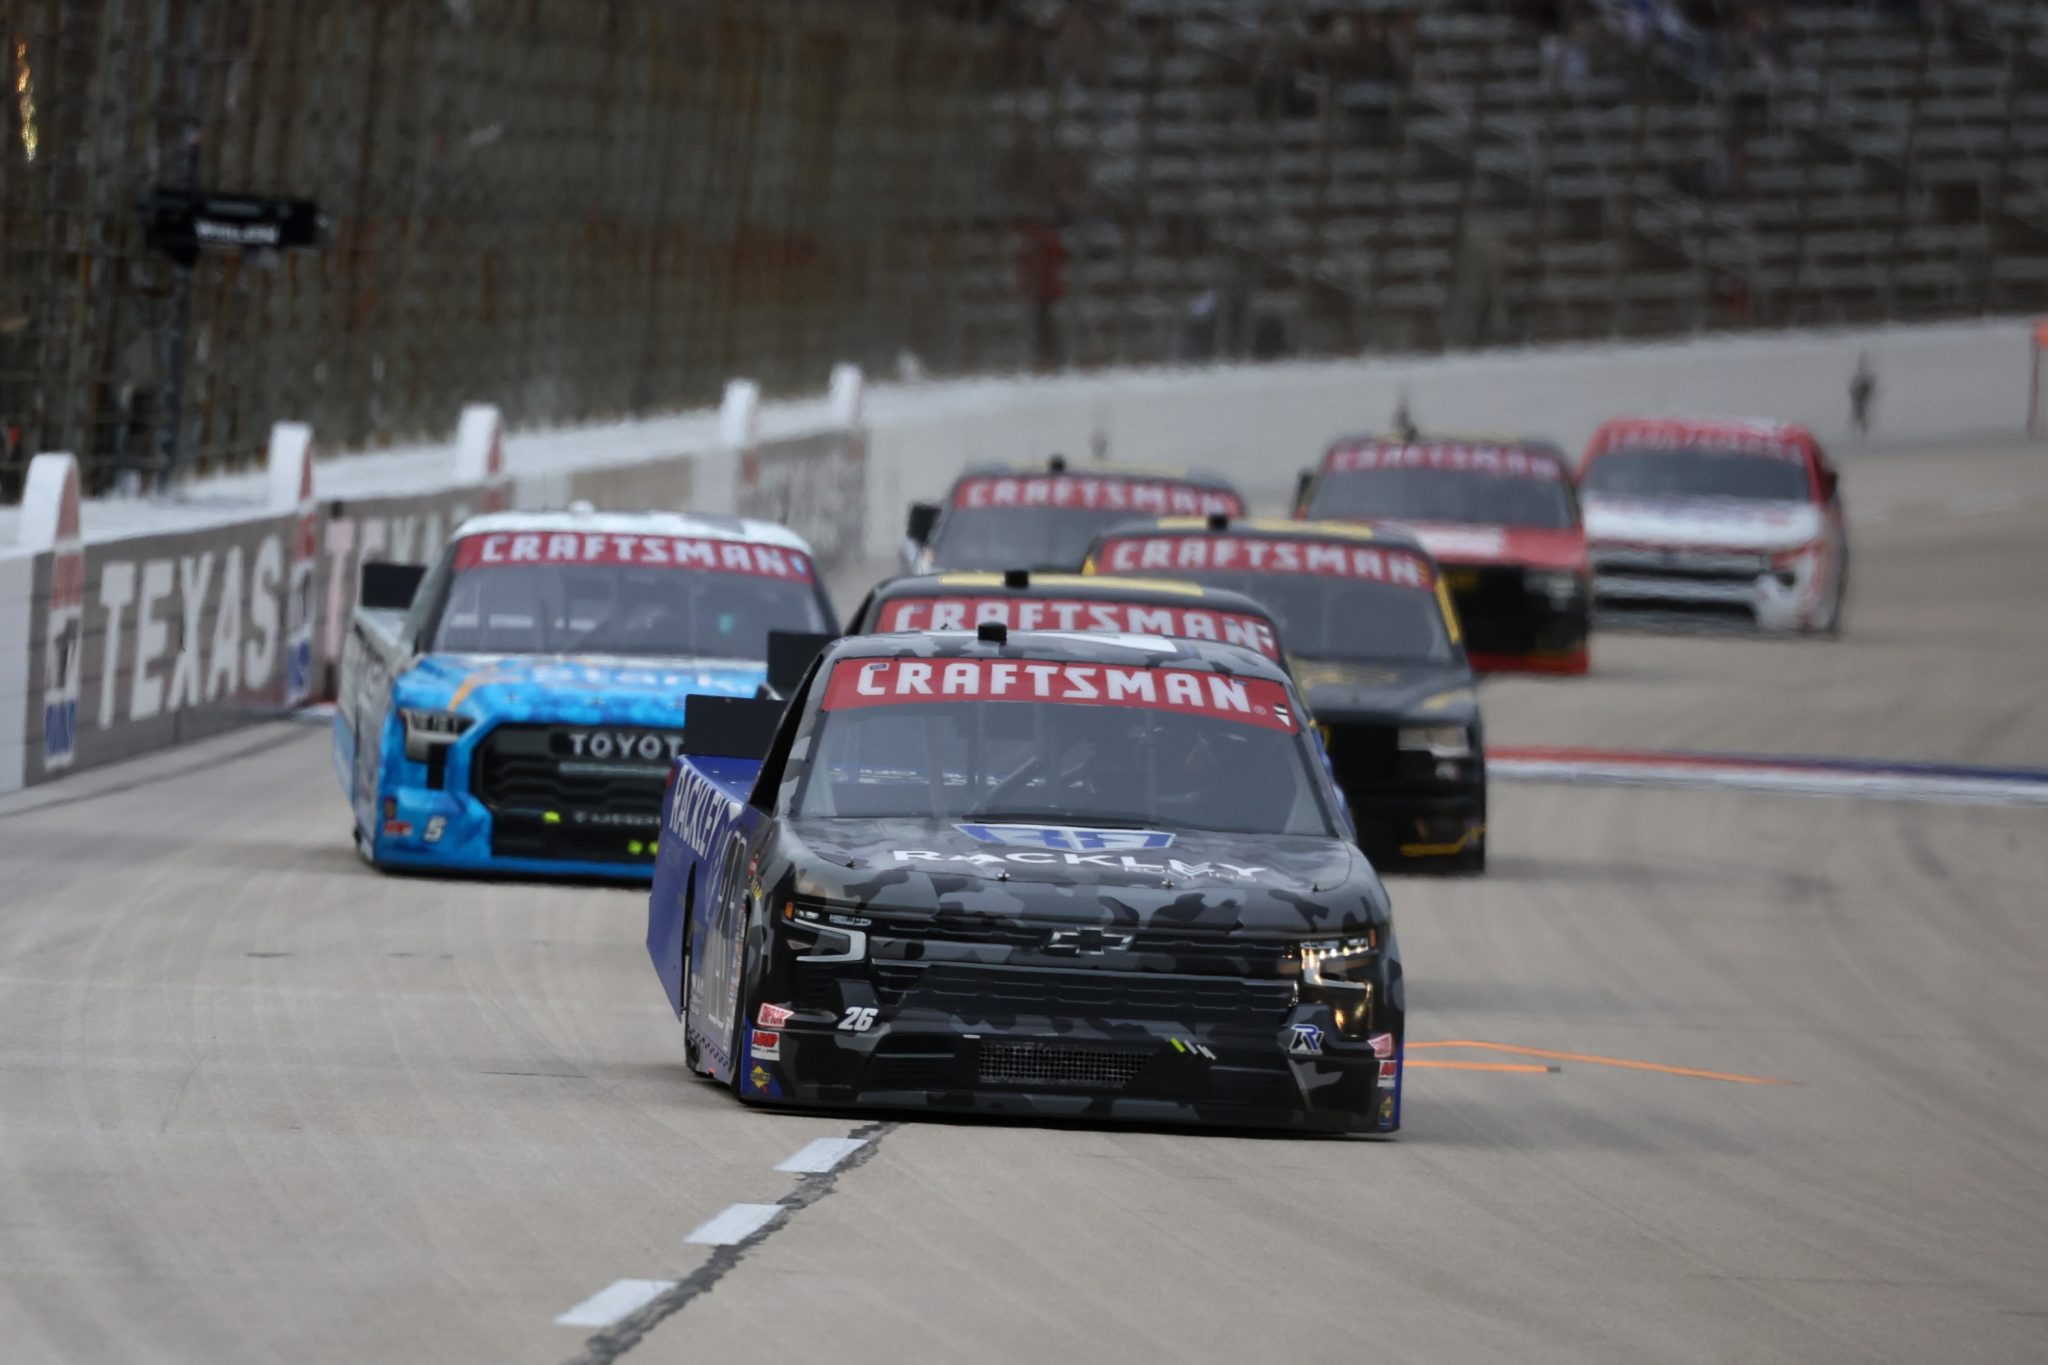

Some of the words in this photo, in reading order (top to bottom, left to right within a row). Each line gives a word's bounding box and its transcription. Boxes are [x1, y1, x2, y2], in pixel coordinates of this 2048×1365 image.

[967, 478, 1228, 518] CRAFTSMAN
[482, 534, 787, 577] CRAFTSMAN
[1112, 538, 1420, 587] CRAFTSMAN
[99, 533, 282, 731] TEXAS
[895, 604, 1273, 650] CRAFTSMAN
[856, 662, 1252, 713] CRAFTSMAN
[423, 815, 446, 842] 5
[669, 764, 730, 861] RACKLEY
[837, 1006, 879, 1032] 26
